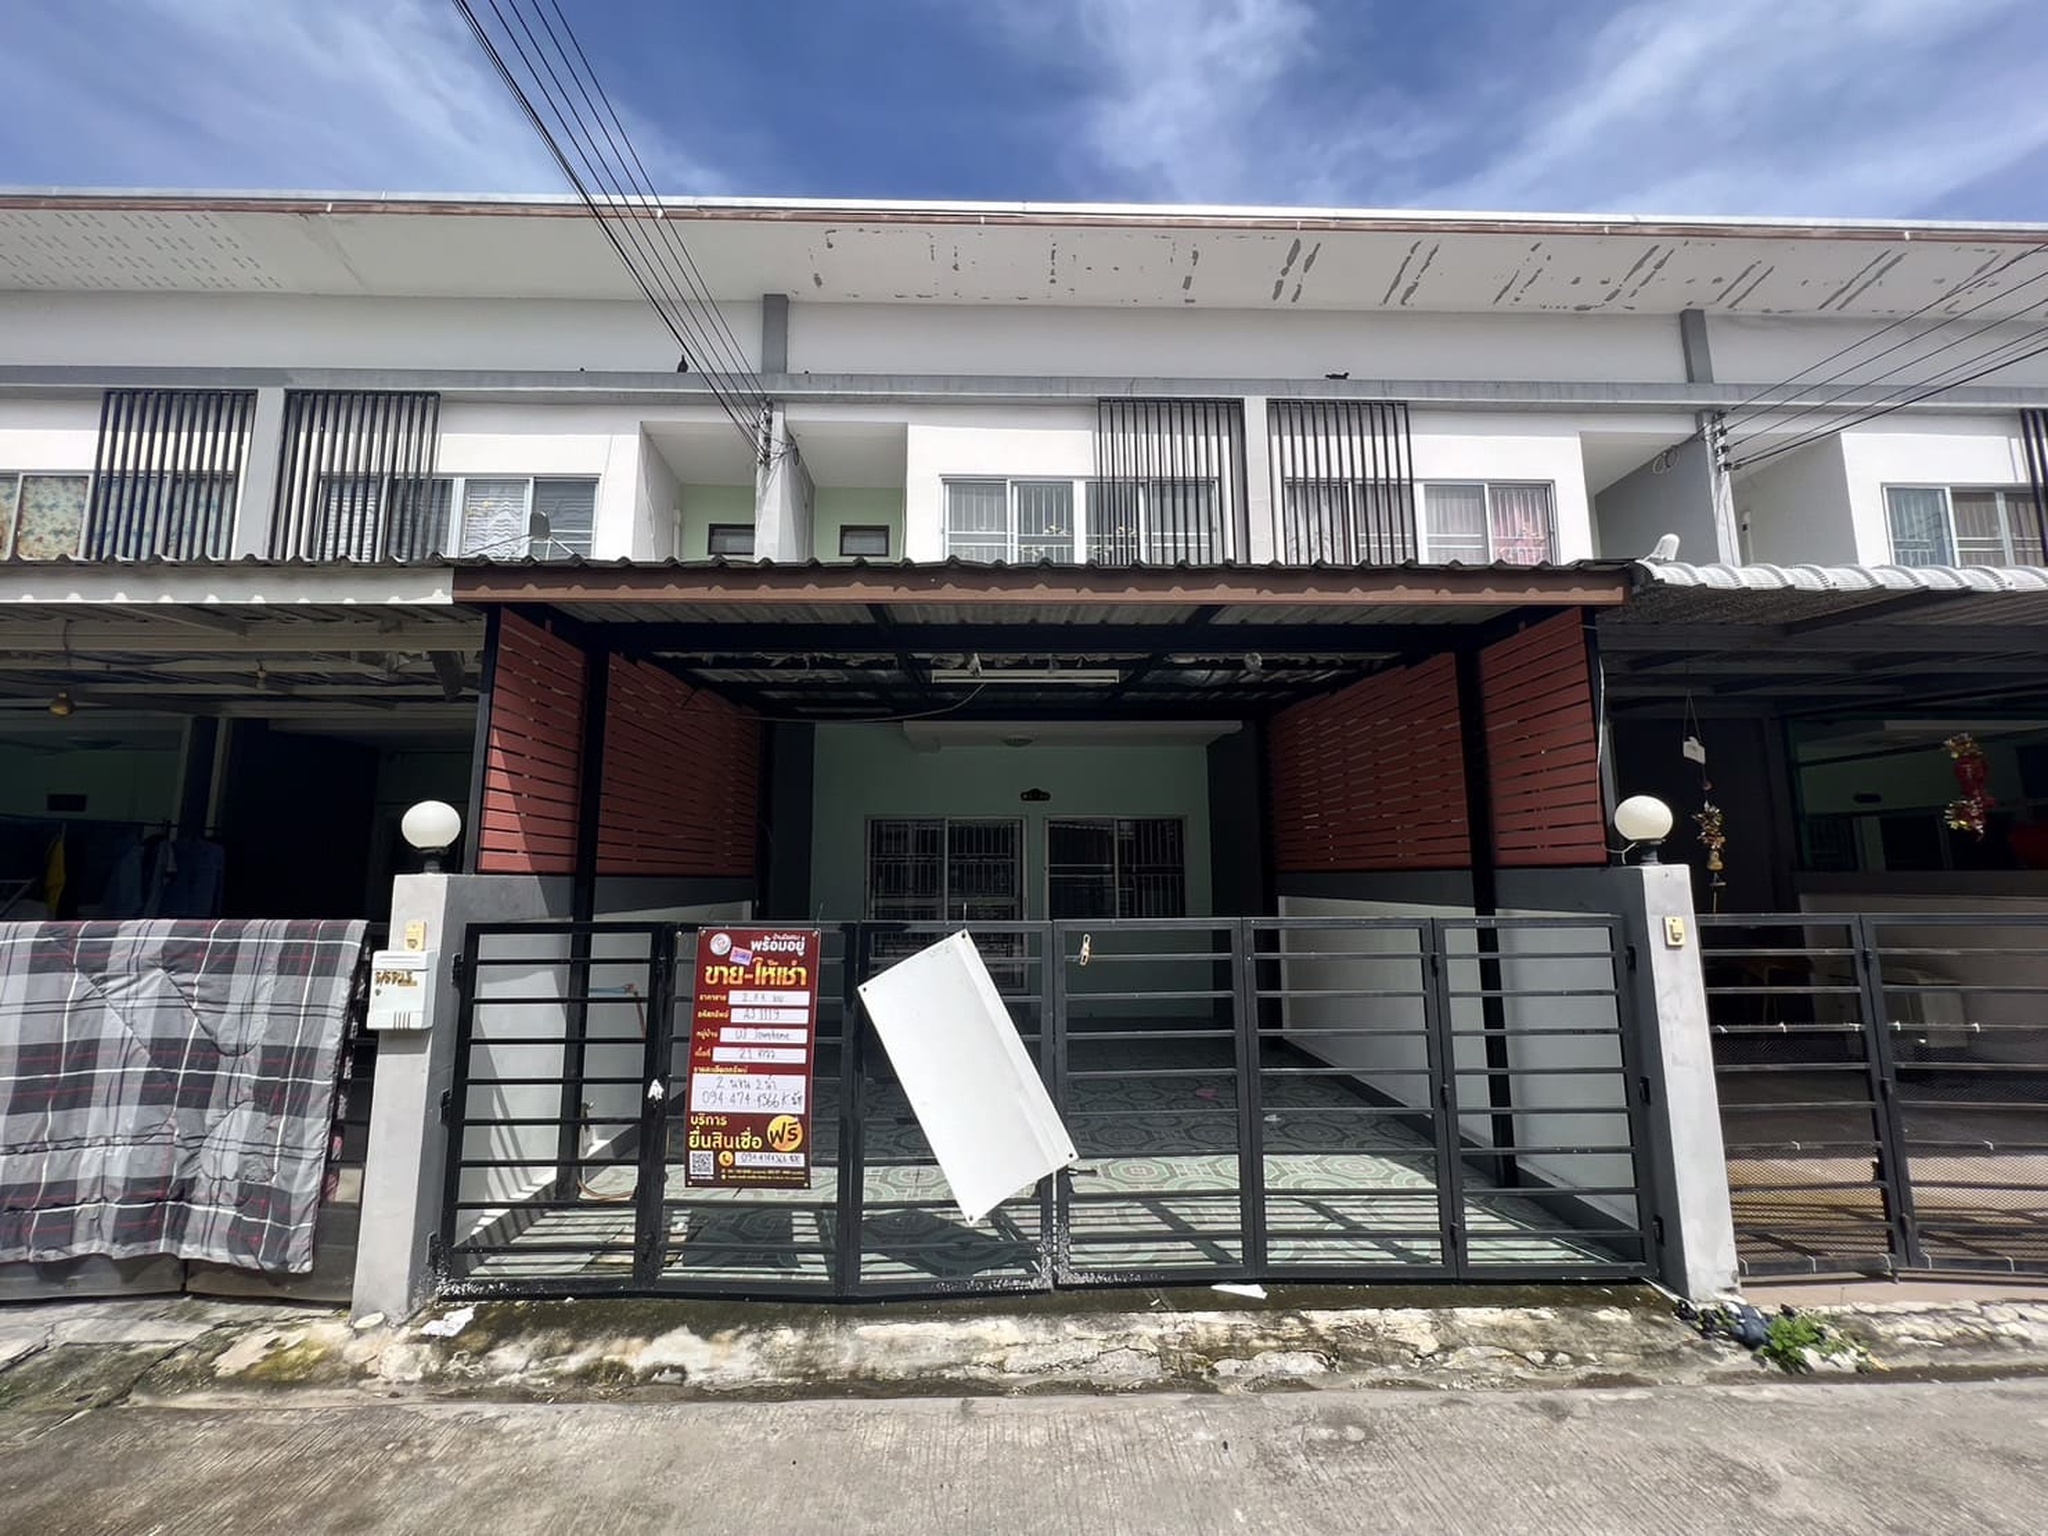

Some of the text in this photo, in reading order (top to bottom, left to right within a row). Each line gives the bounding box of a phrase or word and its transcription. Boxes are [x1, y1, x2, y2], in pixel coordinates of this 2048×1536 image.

[750, 934, 806, 957] พร้อมอยู่
[704, 957, 808, 986] ขาย-ให้เช่า
[690, 1113, 728, 1126] บริการ
[688, 1125, 763, 1149] ยื่นสินเชื่อ
[770, 1120, 799, 1144] ฟรี
